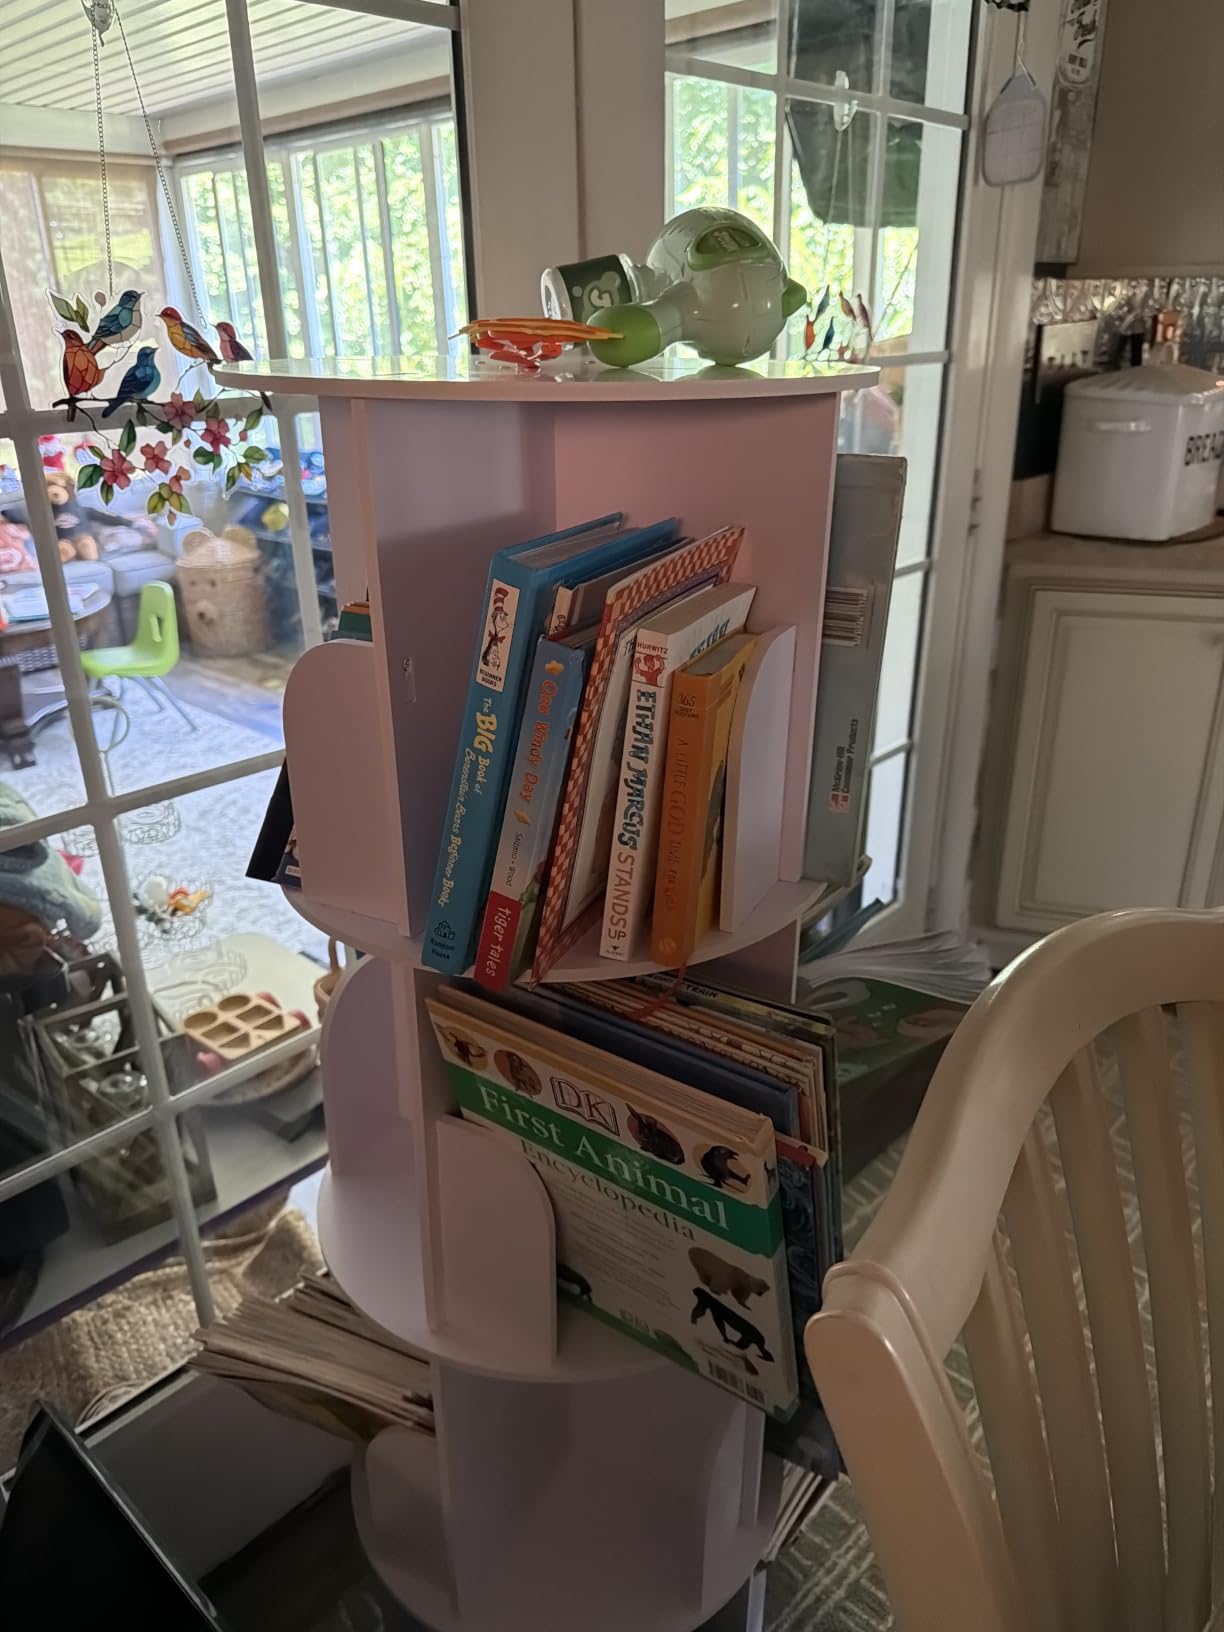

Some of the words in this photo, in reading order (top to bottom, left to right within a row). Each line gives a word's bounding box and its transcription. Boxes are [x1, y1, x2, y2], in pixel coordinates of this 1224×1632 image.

[636, 642, 669, 655] HURWITZ
[479, 668, 502, 682] BEGINNER
[481, 677, 497, 688] BOOKS
[483, 698, 492, 713] The
[537, 679, 558, 716] One
[474, 712, 498, 754] BIG
[528, 720, 550, 767] Windy
[628, 689, 657, 764] ETHAN
[458, 746, 476, 802] Berenstain
[475, 754, 490, 784] Book
[473, 783, 483, 795] of
[520, 771, 539, 804] Day
[452, 801, 467, 834] Bears
[618, 761, 648, 851] MARCUS
[445, 833, 462, 878] Beginner
[438, 877, 455, 911] Books
[505, 866, 516, 887] Wood
[610, 851, 635, 929] STANDS
[493, 907, 512, 942] tiger
[608, 928, 627, 941] UP
[485, 943, 504, 978] tales
[556, 1079, 614, 1129] DK
[477, 1083, 566, 1147] First
[576, 1135, 730, 1231] Animal
[520, 1138, 697, 1242] Encyclopedia
